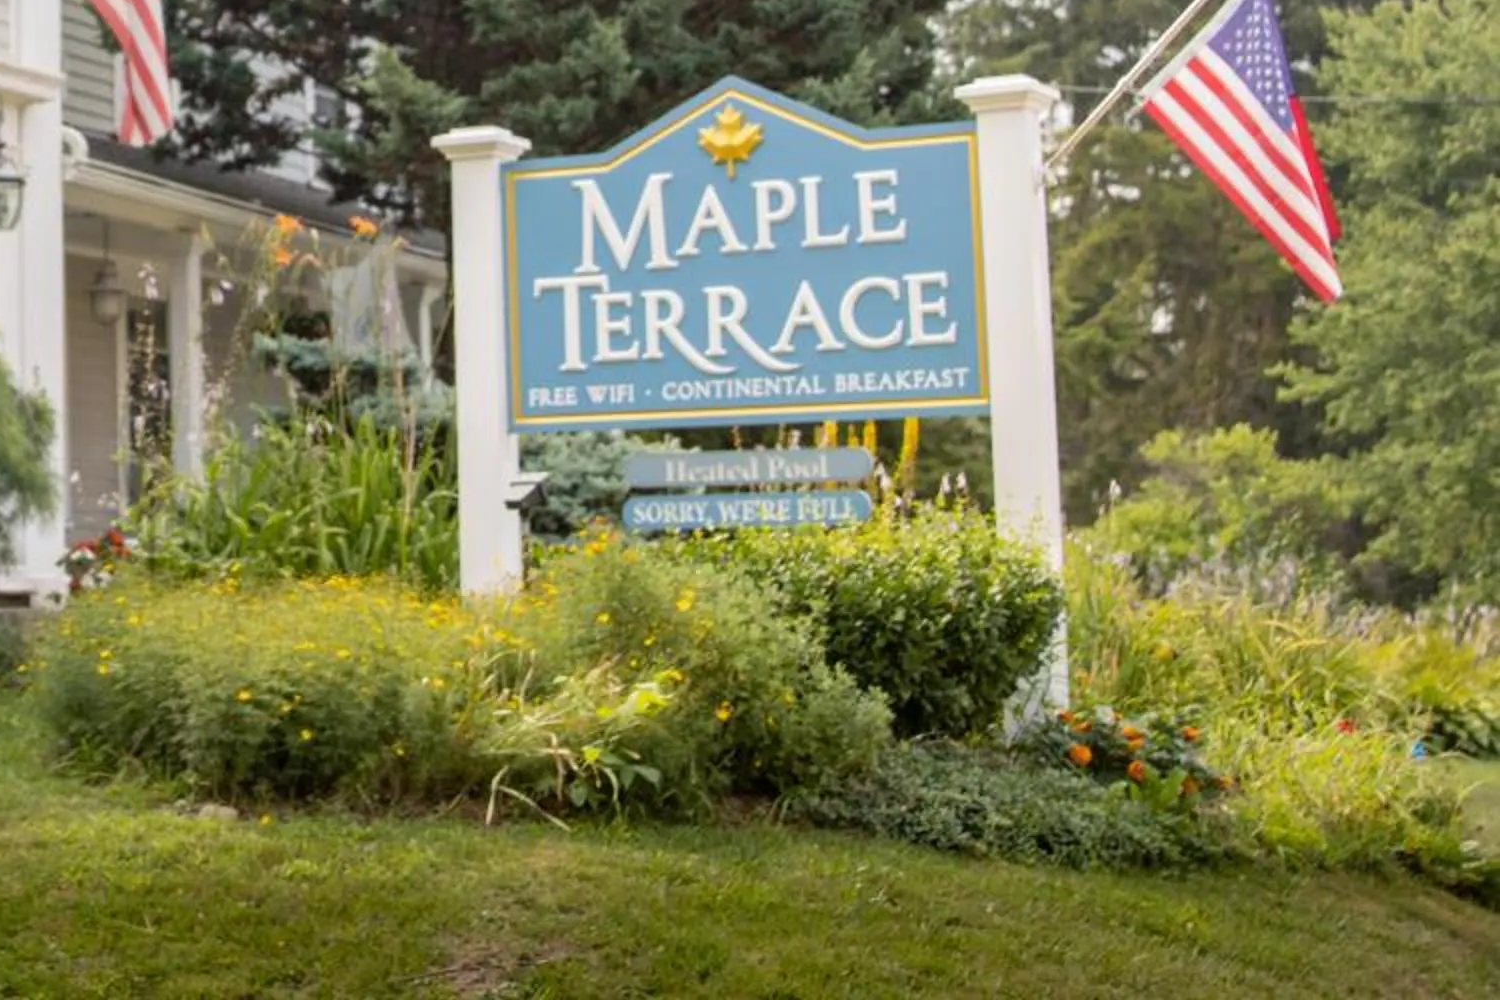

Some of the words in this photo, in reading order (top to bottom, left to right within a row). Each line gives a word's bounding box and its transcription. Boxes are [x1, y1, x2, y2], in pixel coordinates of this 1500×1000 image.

[534, 271, 958, 375] TERRACE
[528, 384, 578, 408] FREE
[585, 383, 636, 404] WIFI
[661, 374, 827, 401] CONTINENTAL
[835, 366, 970, 393] BREAKFAST
[665, 455, 759, 483] Heated
[768, 454, 829, 479] Pool
[797, 497, 856, 522] FULL
